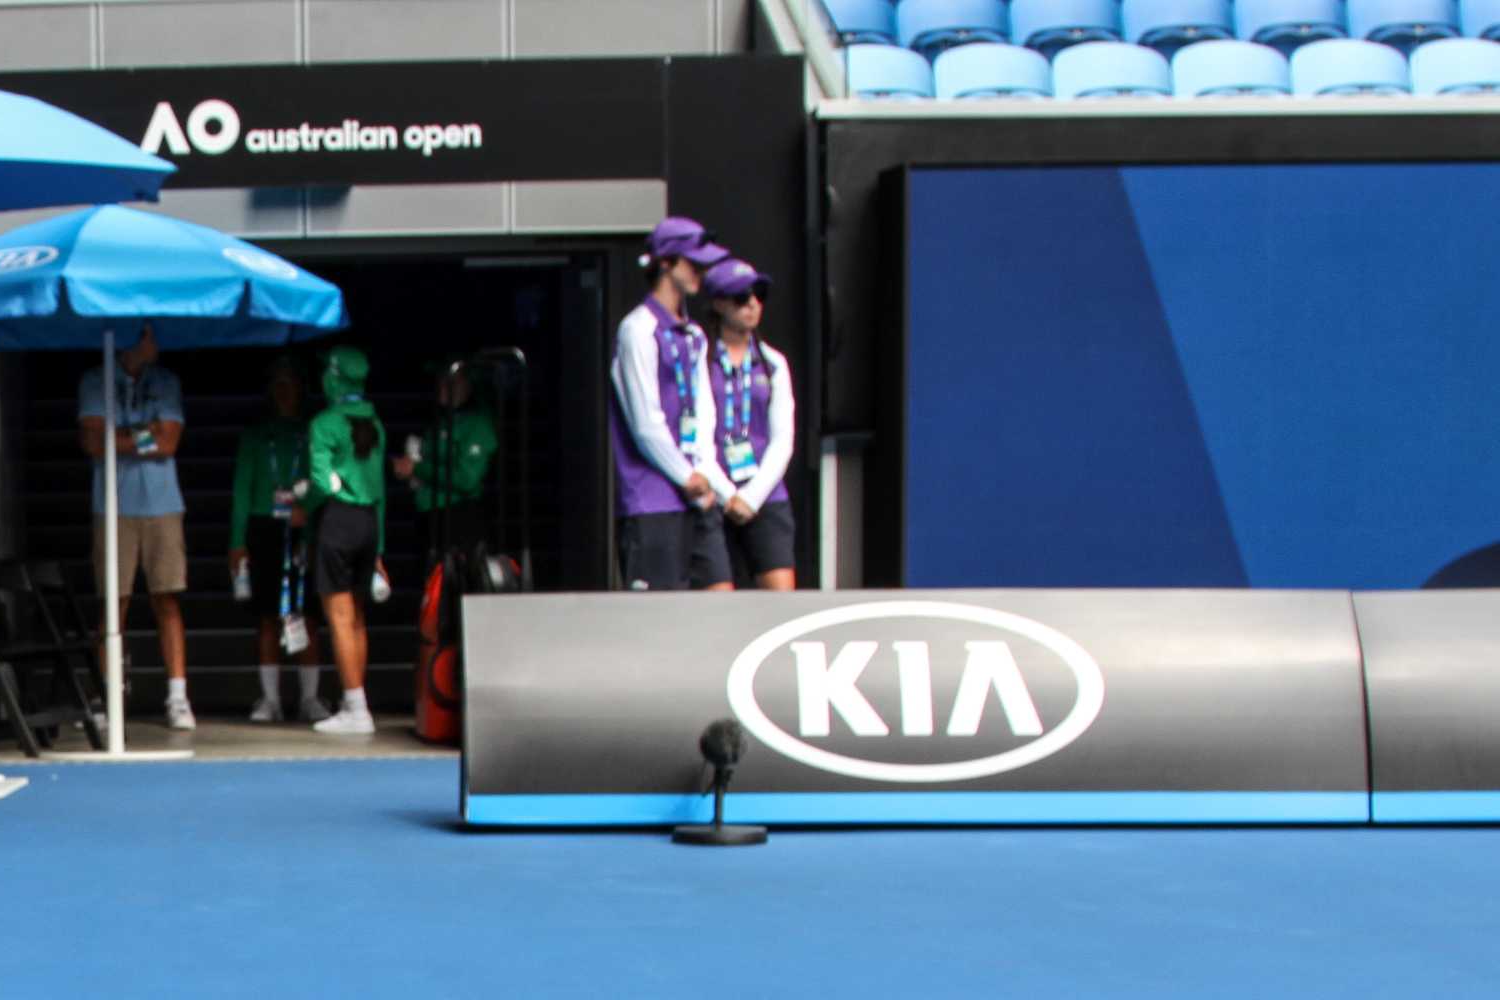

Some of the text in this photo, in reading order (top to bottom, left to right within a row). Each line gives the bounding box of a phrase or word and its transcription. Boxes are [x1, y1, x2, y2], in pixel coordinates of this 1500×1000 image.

[140, 100, 483, 156] AO australian open
[790, 641, 1043, 736] KIA
